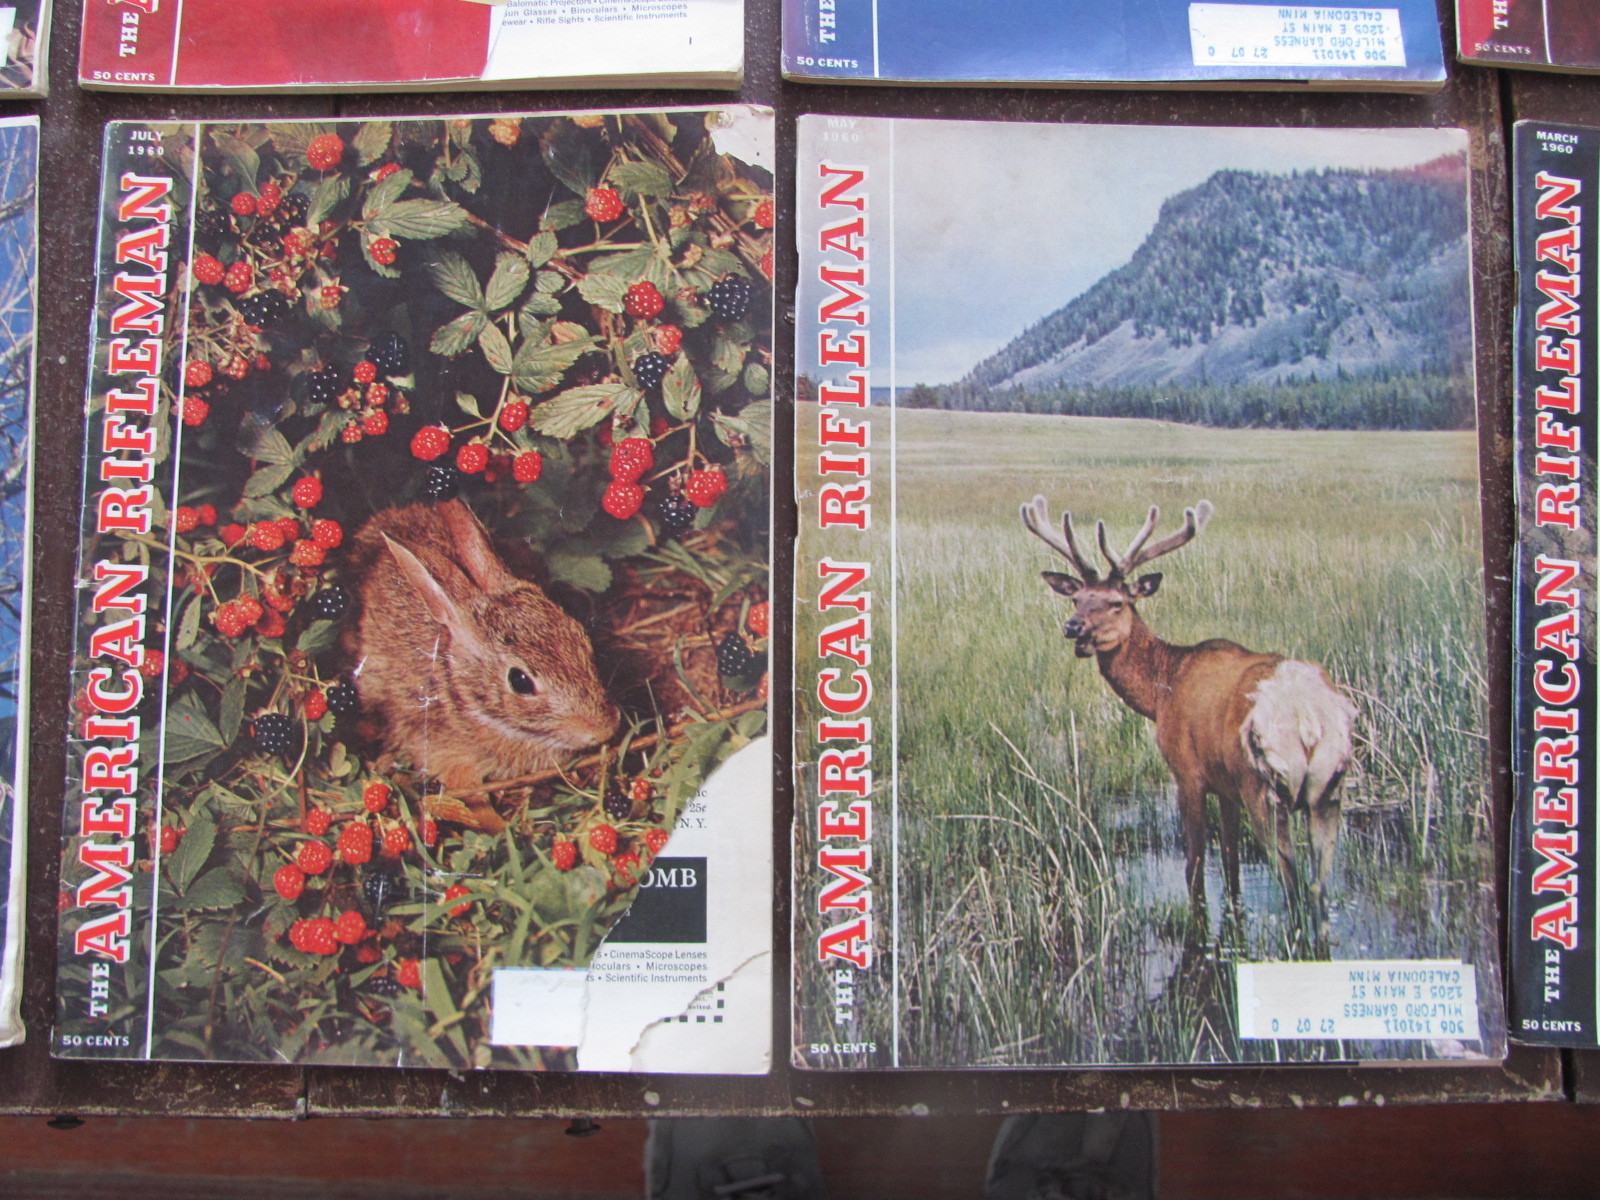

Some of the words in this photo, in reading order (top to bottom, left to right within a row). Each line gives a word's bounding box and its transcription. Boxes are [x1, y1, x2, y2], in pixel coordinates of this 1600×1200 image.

[523, 8, 557, 17] Glasses
[570, 6, 618, 15] Binoculars
[631, 3, 688, 12] Microscopes
[1314, 10, 1382, 21] CALEDONIA
[558, 15, 585, 24] Sights
[594, 14, 633, 22] Scientific
[636, 11, 688, 20] Instruments
[819, 0, 836, 44] THE
[118, 12, 139, 57] THE
[1282, 23, 1295, 33] ST
[1303, 23, 1332, 33] MAIN
[1340, 24, 1347, 34] E
[1331, 37, 1385, 47] MILFORD
[1474, 43, 1490, 51] 50
[1494, 45, 1531, 55] CENTS
[796, 56, 814, 66] 50
[817, 58, 859, 68] CENTS
[93, 71, 111, 80] 50
[115, 72, 155, 81] CENTS
[827, 119, 857, 129] MAY
[130, 131, 164, 141] JULY
[1536, 131, 1578, 144] MARCH
[128, 146, 164, 155] 1960
[1541, 142, 1573, 154] 1960
[818, 159, 871, 531] RIFLEMAN
[1535, 171, 1581, 531] RIFLEMAN
[98, 172, 173, 535] RIFLEMAN
[1531, 553, 1581, 950] AMERICAN
[75, 559, 149, 962] AMERICAN
[817, 557, 872, 969] AMERICAN
[610, 950, 673, 961] CinemaScope
[675, 950, 707, 959] Lenses
[646, 962, 708, 972] Microscopes
[605, 974, 649, 983] Scientific
[651, 974, 707, 982] Instruments
[1349, 970, 1381, 982] MINN
[1389, 970, 1460, 983] CALEDONIA
[1544, 949, 1560, 1003] THE
[89, 963, 110, 1018] THE
[835, 969, 853, 1025] THE
[1351, 985, 1366, 998] ST
[1374, 985, 1405, 997] MAIN
[1413, 985, 1422, 997] E
[1430, 985, 1462, 998] 1205
[1344, 1003, 1398, 1017] GARNESS
[1406, 1003, 1462, 1016] MILFORD
[1297, 1018, 1311, 1033] 07
[1320, 1019, 1335, 1032] 27
[1522, 1019, 1539, 1030] 50
[1542, 1020, 1582, 1032] CENTS
[62, 1035, 81, 1046] 50
[86, 1035, 130, 1047] CENTS
[810, 1043, 829, 1054] 50
[834, 1042, 877, 1053] CENTS
